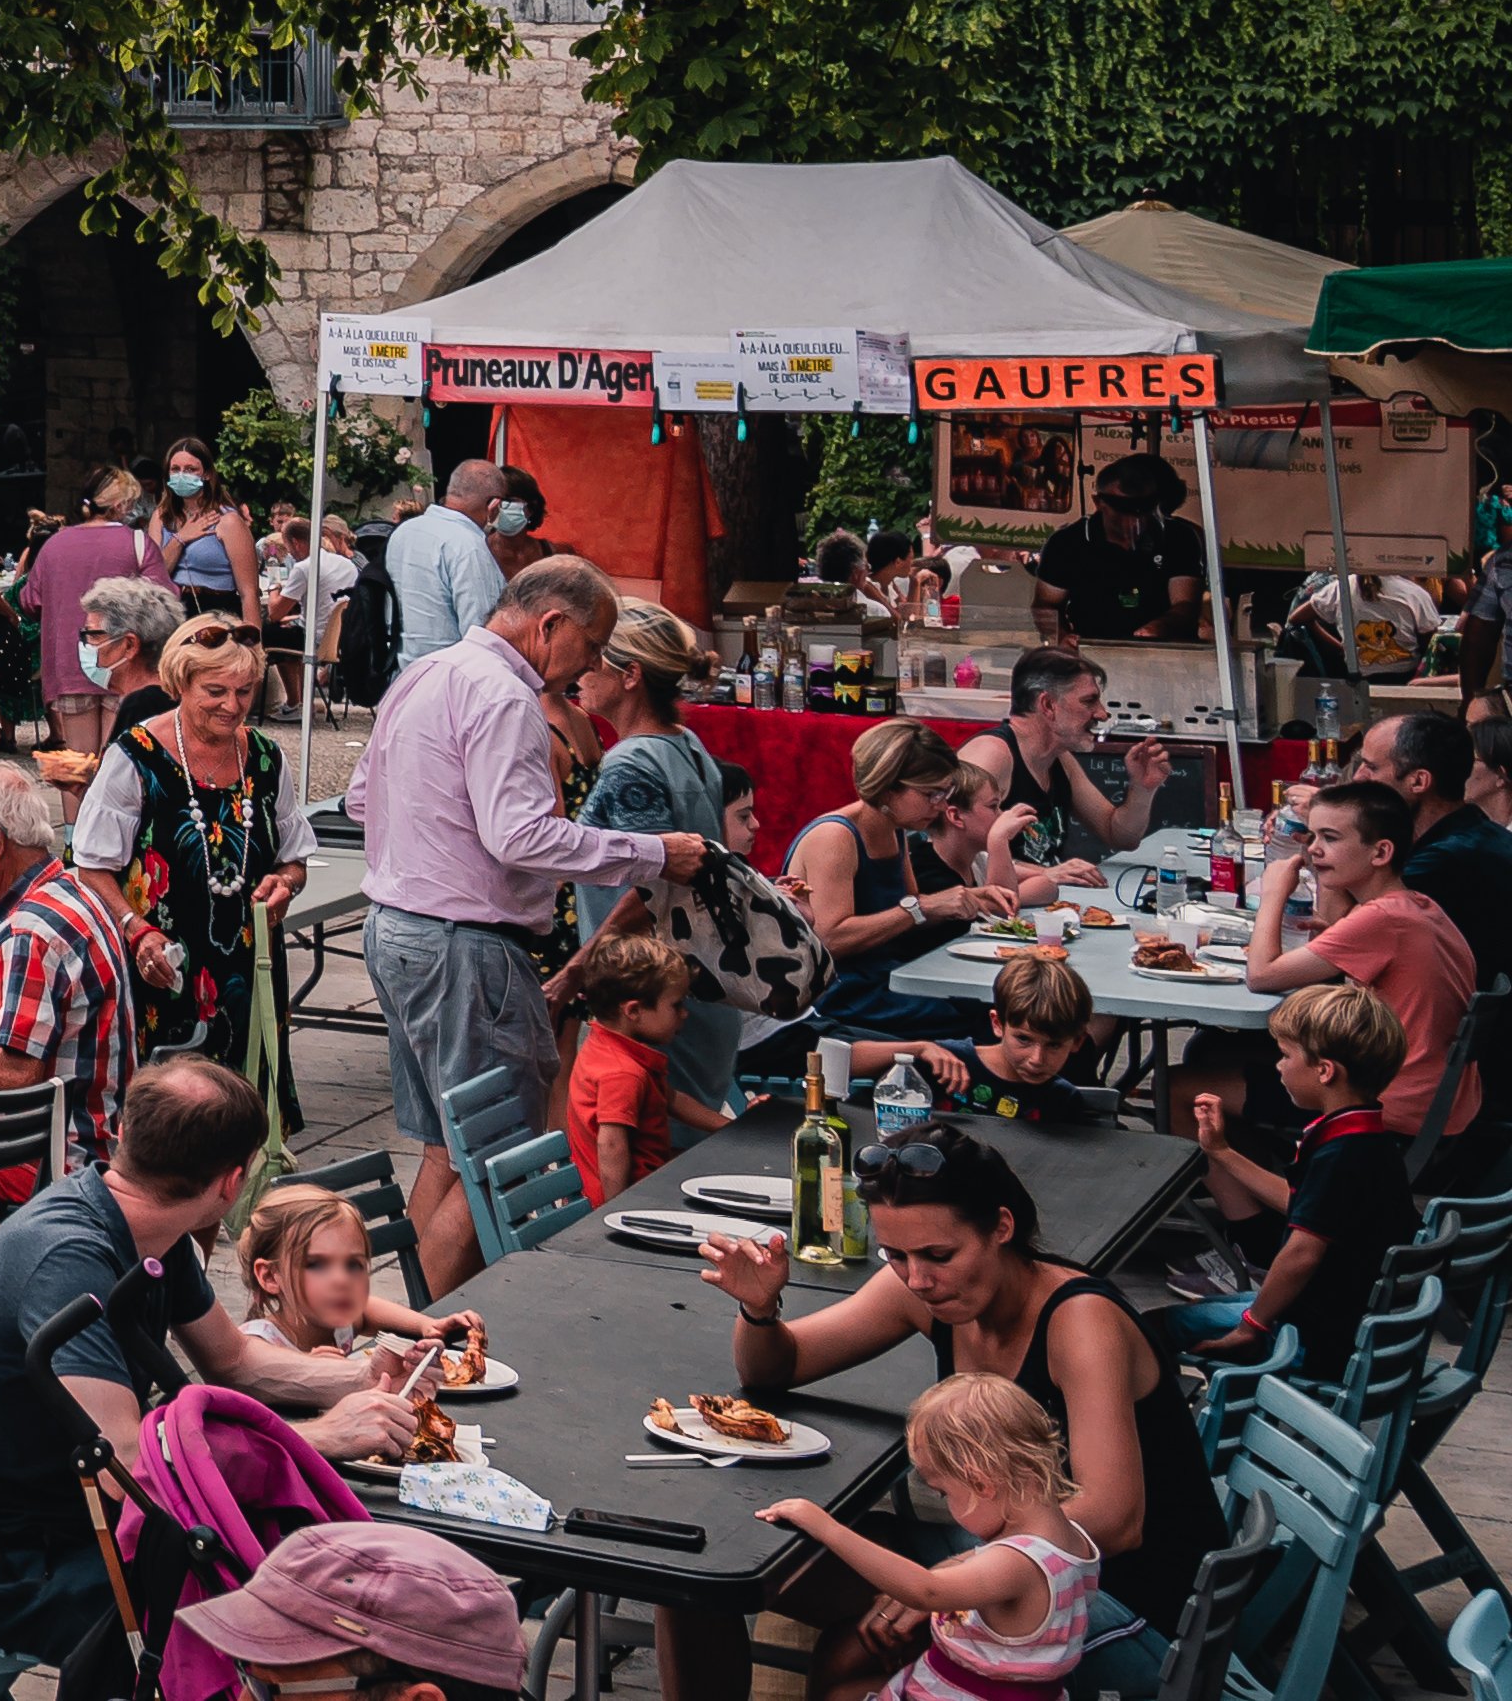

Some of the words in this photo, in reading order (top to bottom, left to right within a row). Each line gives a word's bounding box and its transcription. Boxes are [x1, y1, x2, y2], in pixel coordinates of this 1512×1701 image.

[353, 329, 363, 340] LA
[343, 345, 361, 357] MAIS
[769, 343, 781, 355] LA
[351, 358, 361, 368] DE
[363, 359, 397, 370] DISTANCE
[758, 361, 779, 372] MAIS
[426, 349, 552, 389] Pruneaux
[557, 351, 654, 403] D'Agen
[769, 373, 779, 384] DE
[781, 373, 821, 384] DISTANCE
[925, 363, 1206, 401] GAUFRES
[1230, 413, 1297, 426] Plessis
